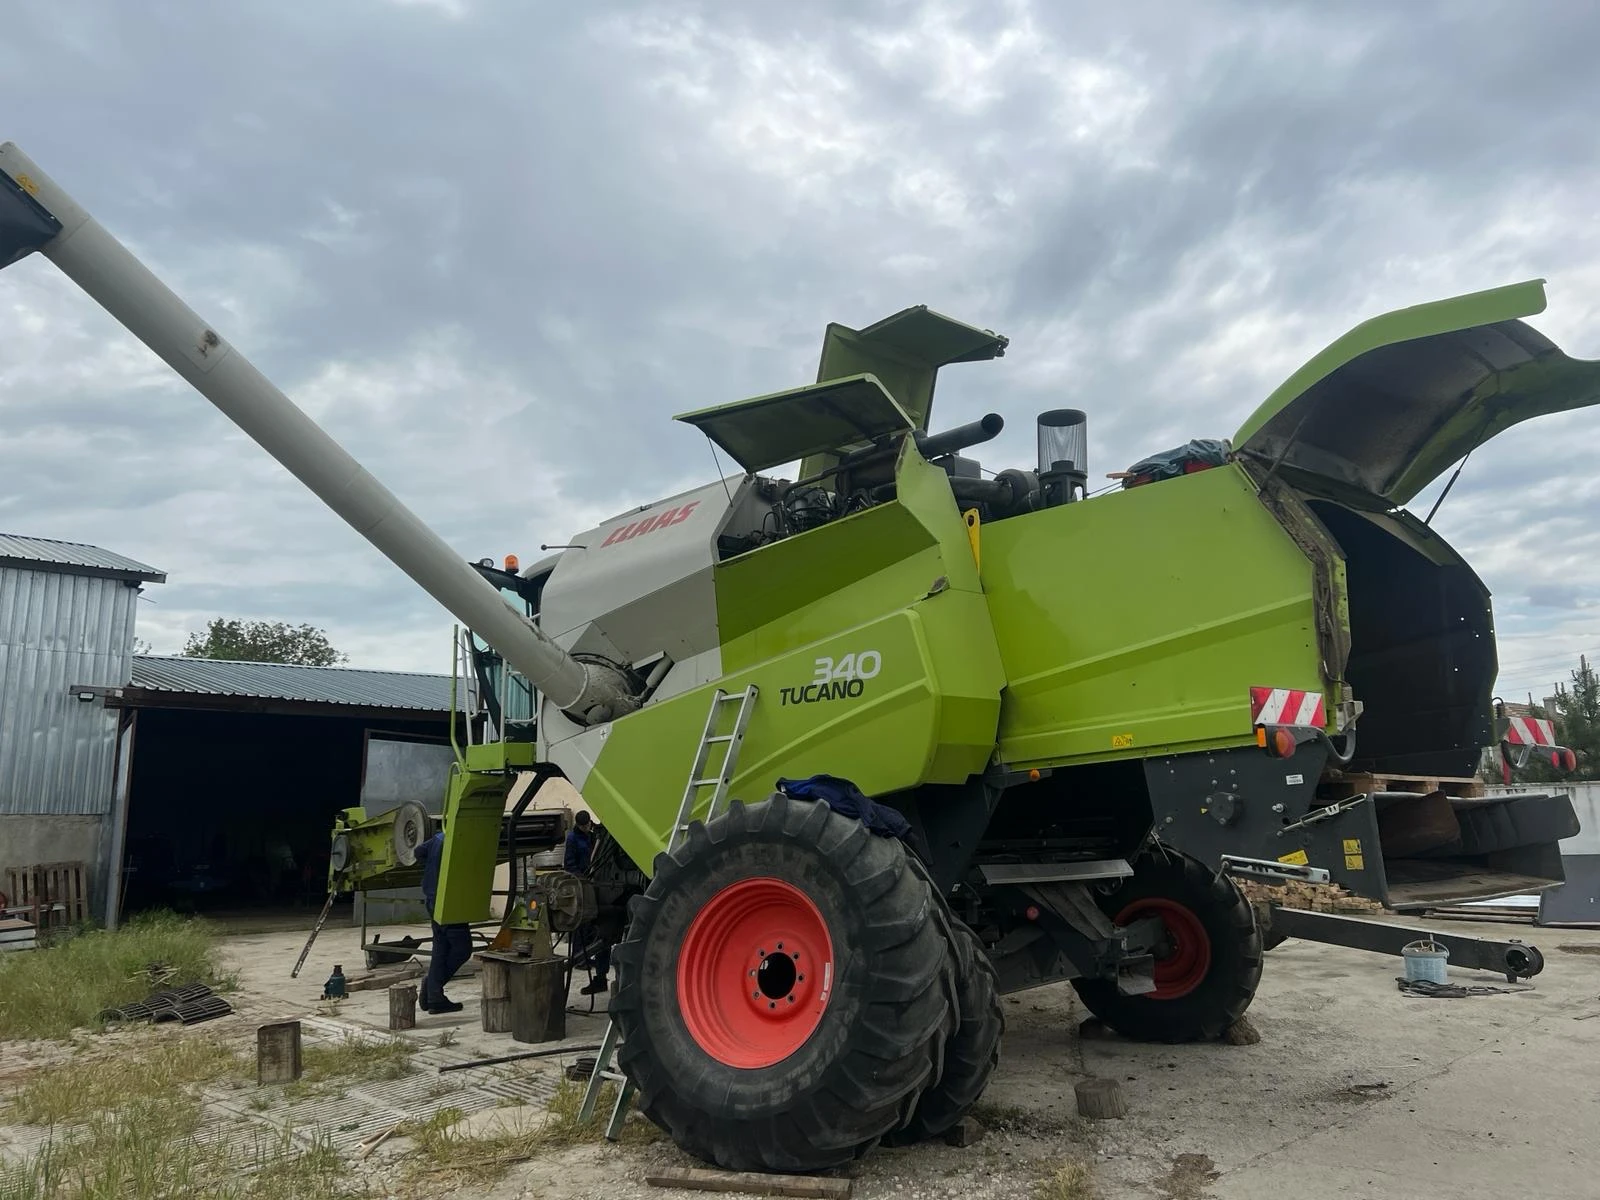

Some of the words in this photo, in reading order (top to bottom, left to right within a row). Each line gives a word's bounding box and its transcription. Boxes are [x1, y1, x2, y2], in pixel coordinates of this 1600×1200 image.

[601, 501, 700, 548] CLAAS
[812, 650, 882, 686] 340
[780, 678, 864, 706] TUCANO
